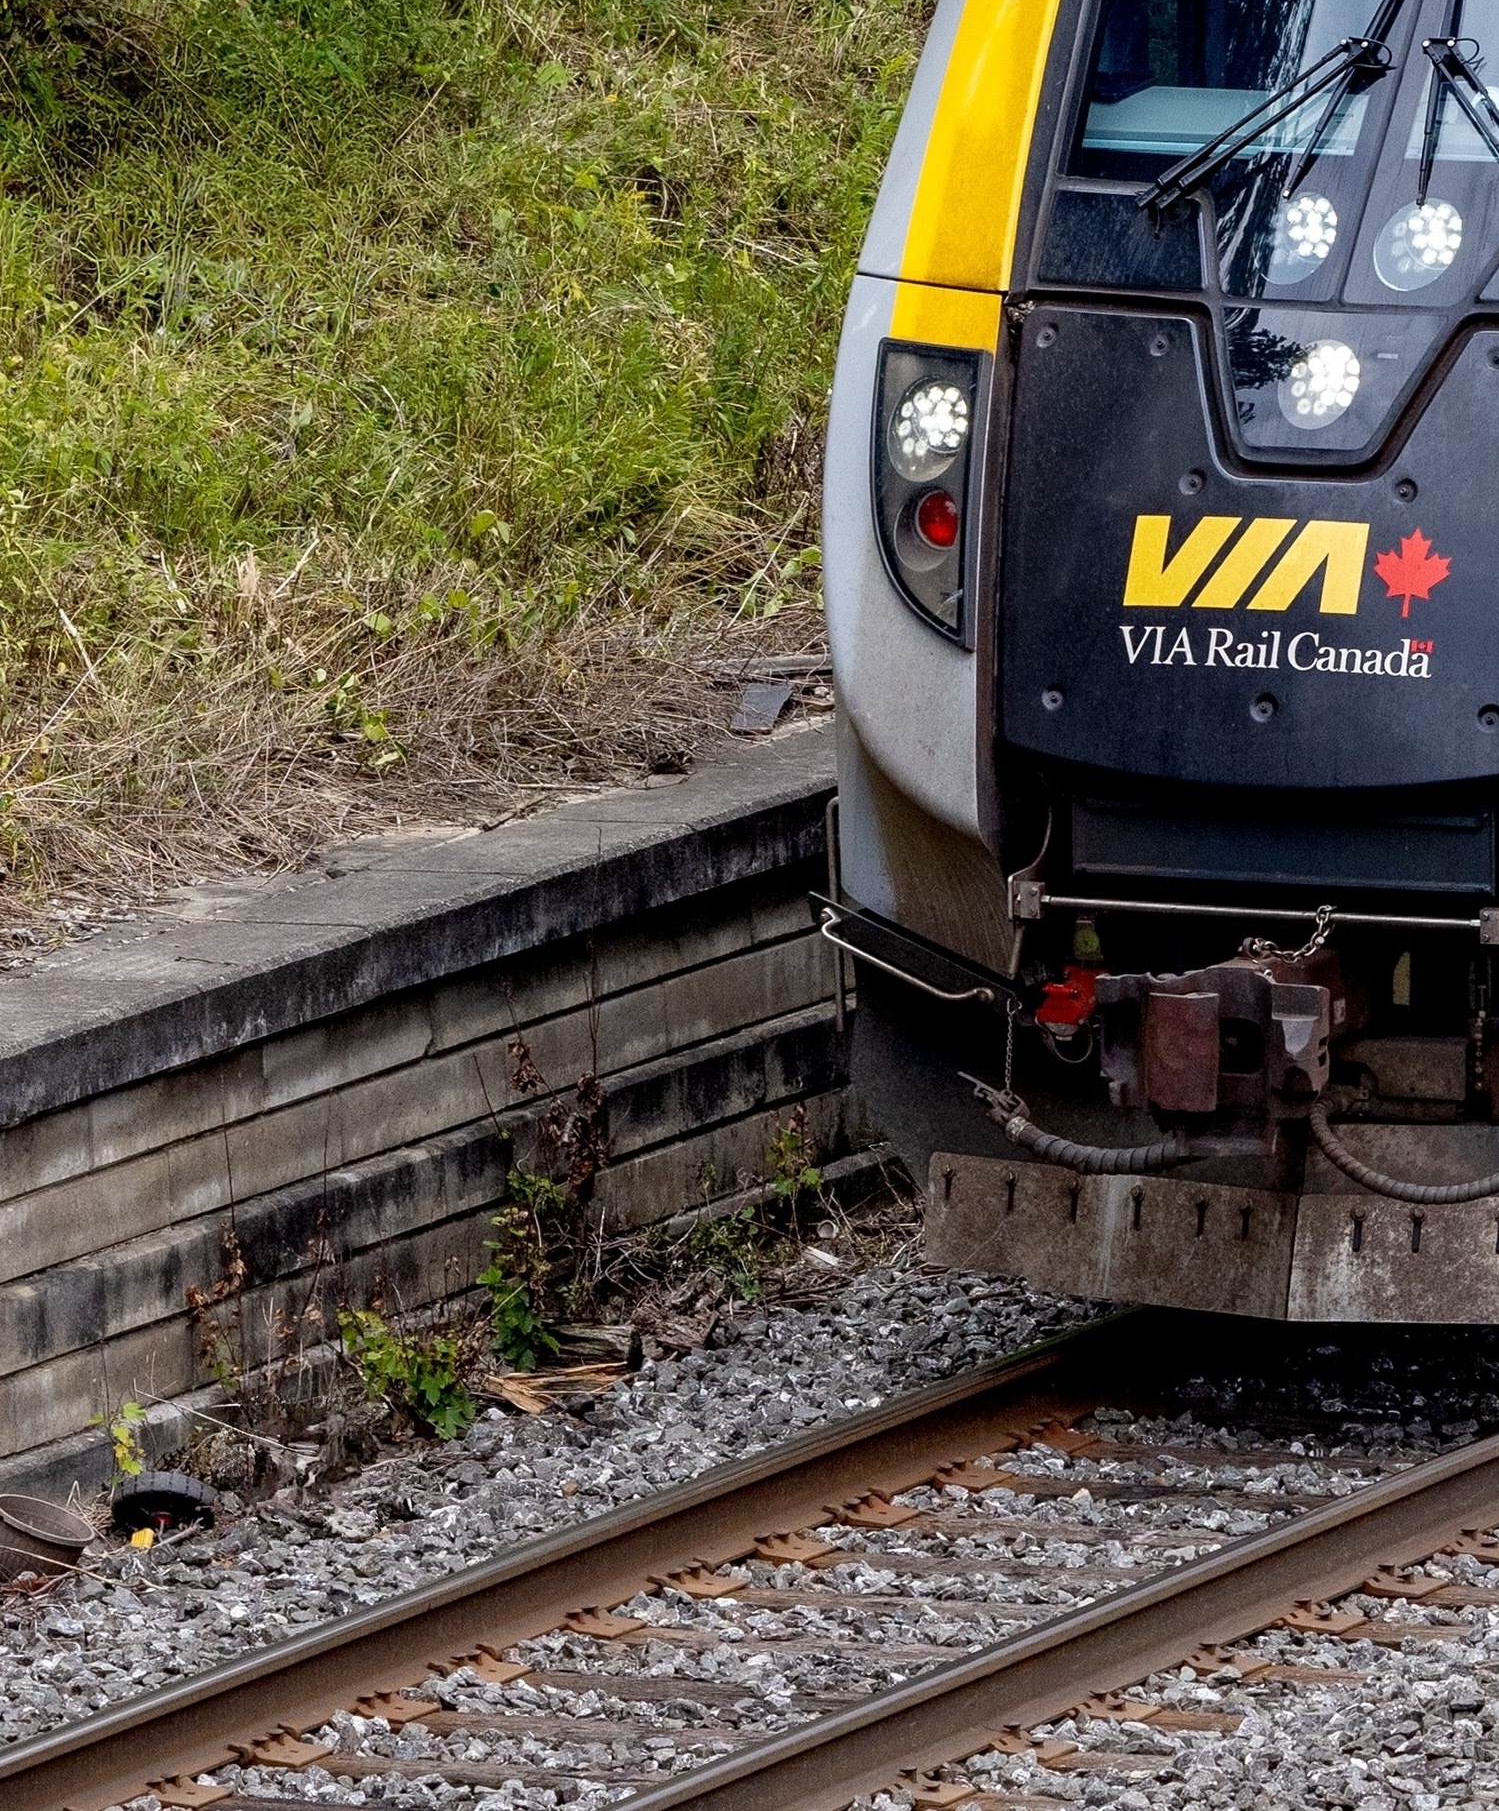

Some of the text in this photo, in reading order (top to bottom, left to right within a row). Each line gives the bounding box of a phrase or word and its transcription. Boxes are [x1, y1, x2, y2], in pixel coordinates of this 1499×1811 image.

[1123, 515, 1370, 615] VIA
[1118, 625, 1432, 679] VIA Rail Canada
